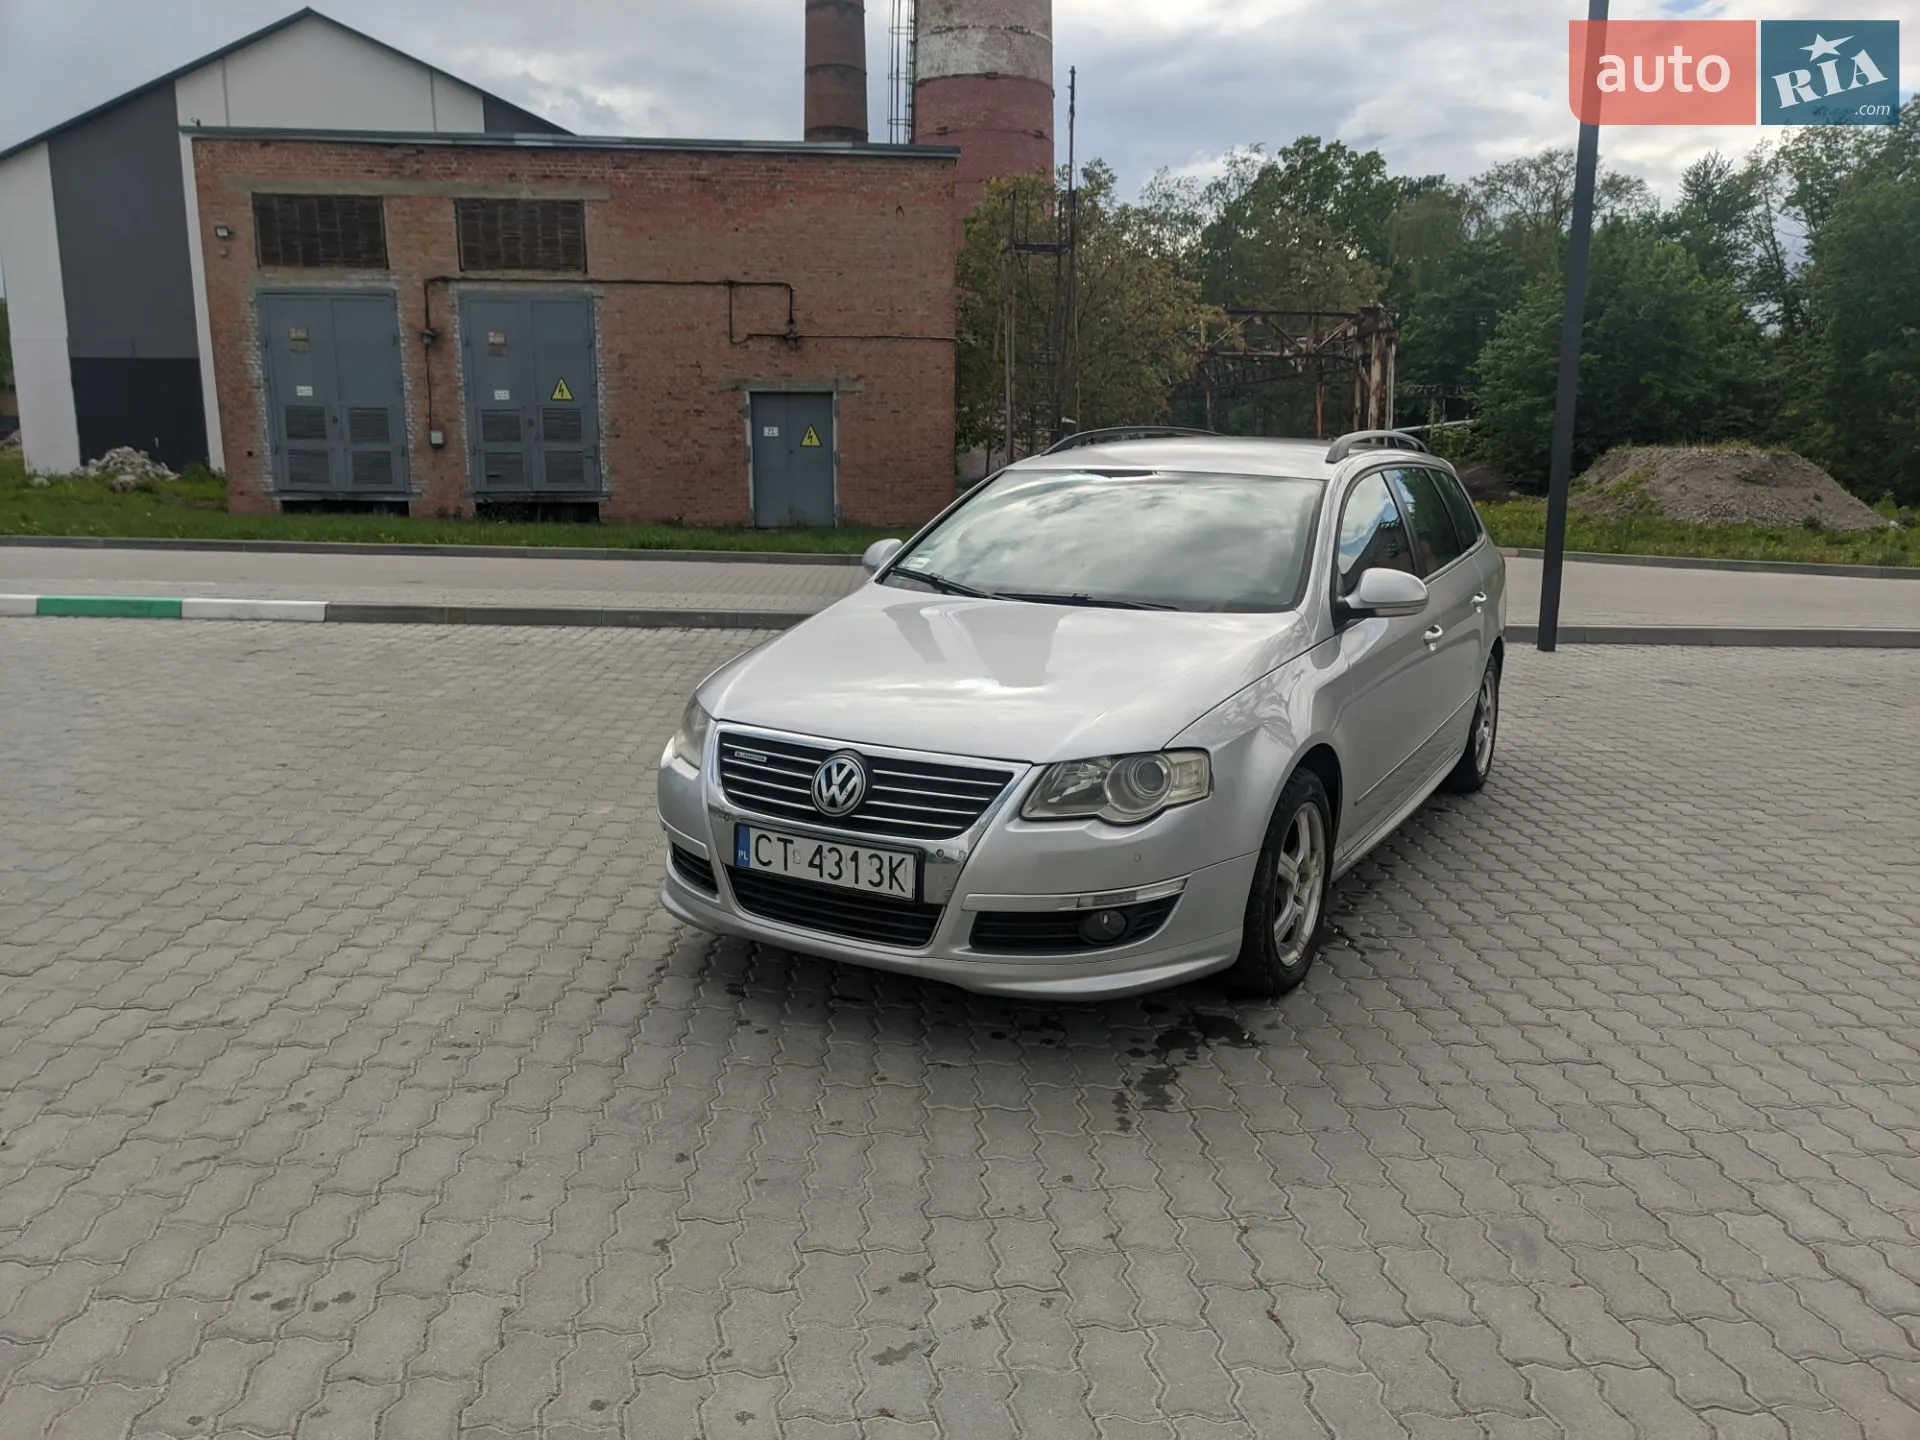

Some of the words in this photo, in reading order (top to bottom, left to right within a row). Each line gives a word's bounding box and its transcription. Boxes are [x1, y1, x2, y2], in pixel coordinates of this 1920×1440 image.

[817, 760, 860, 810] VW
[738, 850, 748, 861] PL
[755, 833, 794, 871] CT
[808, 844, 906, 893] 4313K
